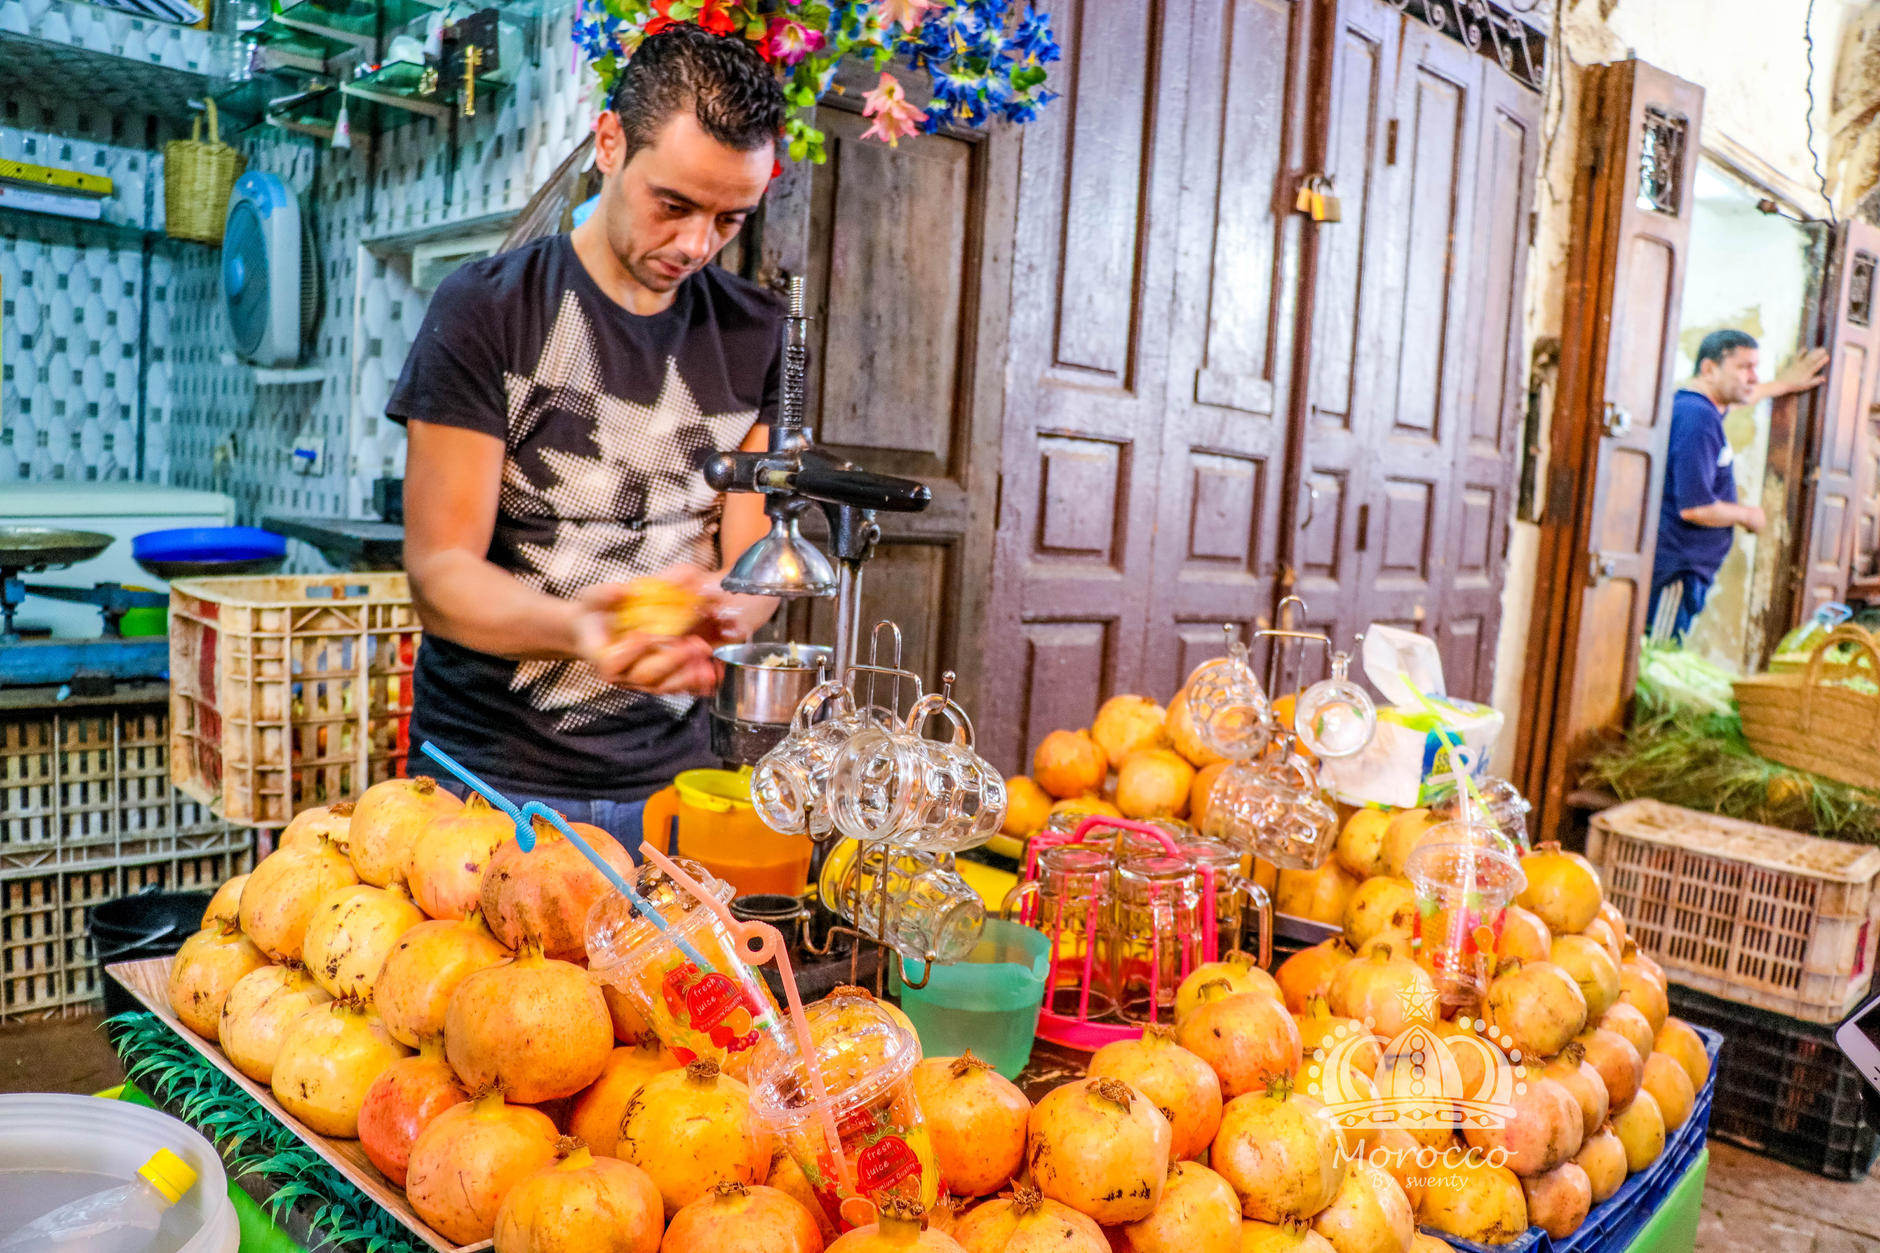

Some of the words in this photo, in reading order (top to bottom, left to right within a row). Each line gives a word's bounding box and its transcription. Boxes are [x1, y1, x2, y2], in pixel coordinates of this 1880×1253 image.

[694, 978, 716, 997] fresh
[697, 996, 716, 1015] juice
[867, 1141, 892, 1160] fresh
[866, 1160, 889, 1179] juice
